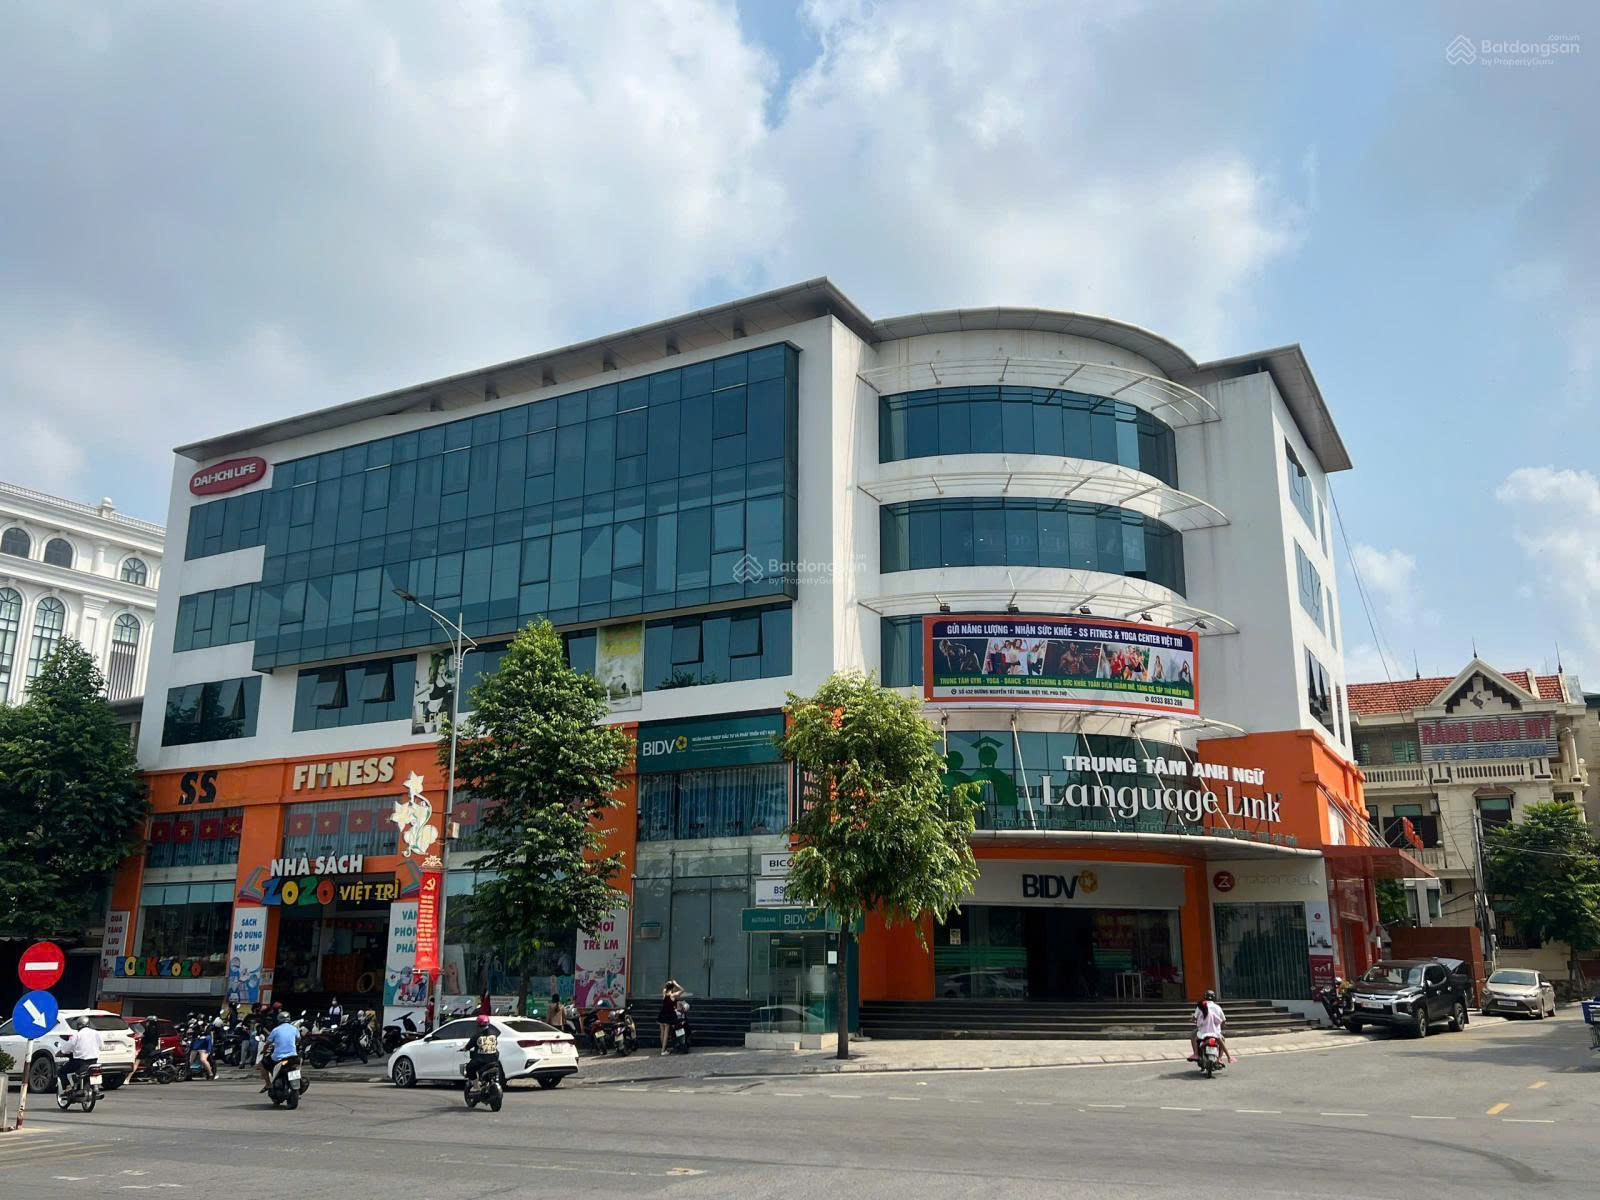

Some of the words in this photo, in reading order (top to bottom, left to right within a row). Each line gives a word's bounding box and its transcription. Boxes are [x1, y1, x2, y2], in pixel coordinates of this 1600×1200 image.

[234, 463, 257, 477] LIFE
[947, 622, 960, 635] GỬI
[961, 623, 982, 635] NĂNG
[984, 624, 1009, 636] LƯỢNG
[1015, 623, 1036, 638] NHẬN
[1037, 623, 1052, 636] SỨC
[1054, 624, 1073, 637] KHỎE
[1079, 628, 1089, 637] SS
[1090, 629, 1113, 640] FITNES
[1114, 631, 1120, 640] &
[1121, 631, 1137, 641] YOGA
[1138, 633, 1160, 644] CENTER
[1160, 636, 1174, 647] VIỆT
[1174, 636, 1183, 648] TRÌ
[642, 739, 676, 757] BIDV
[292, 756, 396, 791] FITNESS
[1062, 755, 1137, 774] TRUNG
[1143, 756, 1187, 776] TÂM
[1192, 762, 1229, 780] ANH
[1232, 767, 1265, 786] NGỮ
[178, 769, 219, 806] SS
[1038, 775, 1218, 822] Language
[1224, 786, 1282, 823] Link
[271, 852, 311, 877] NHÀ
[314, 851, 364, 875] SÁCH
[261, 875, 335, 906] ZOZO
[339, 881, 372, 905] VIỆT
[374, 879, 400, 901] TRÌ
[1022, 873, 1079, 900] BIDV
[783, 914, 807, 925] BIDV
